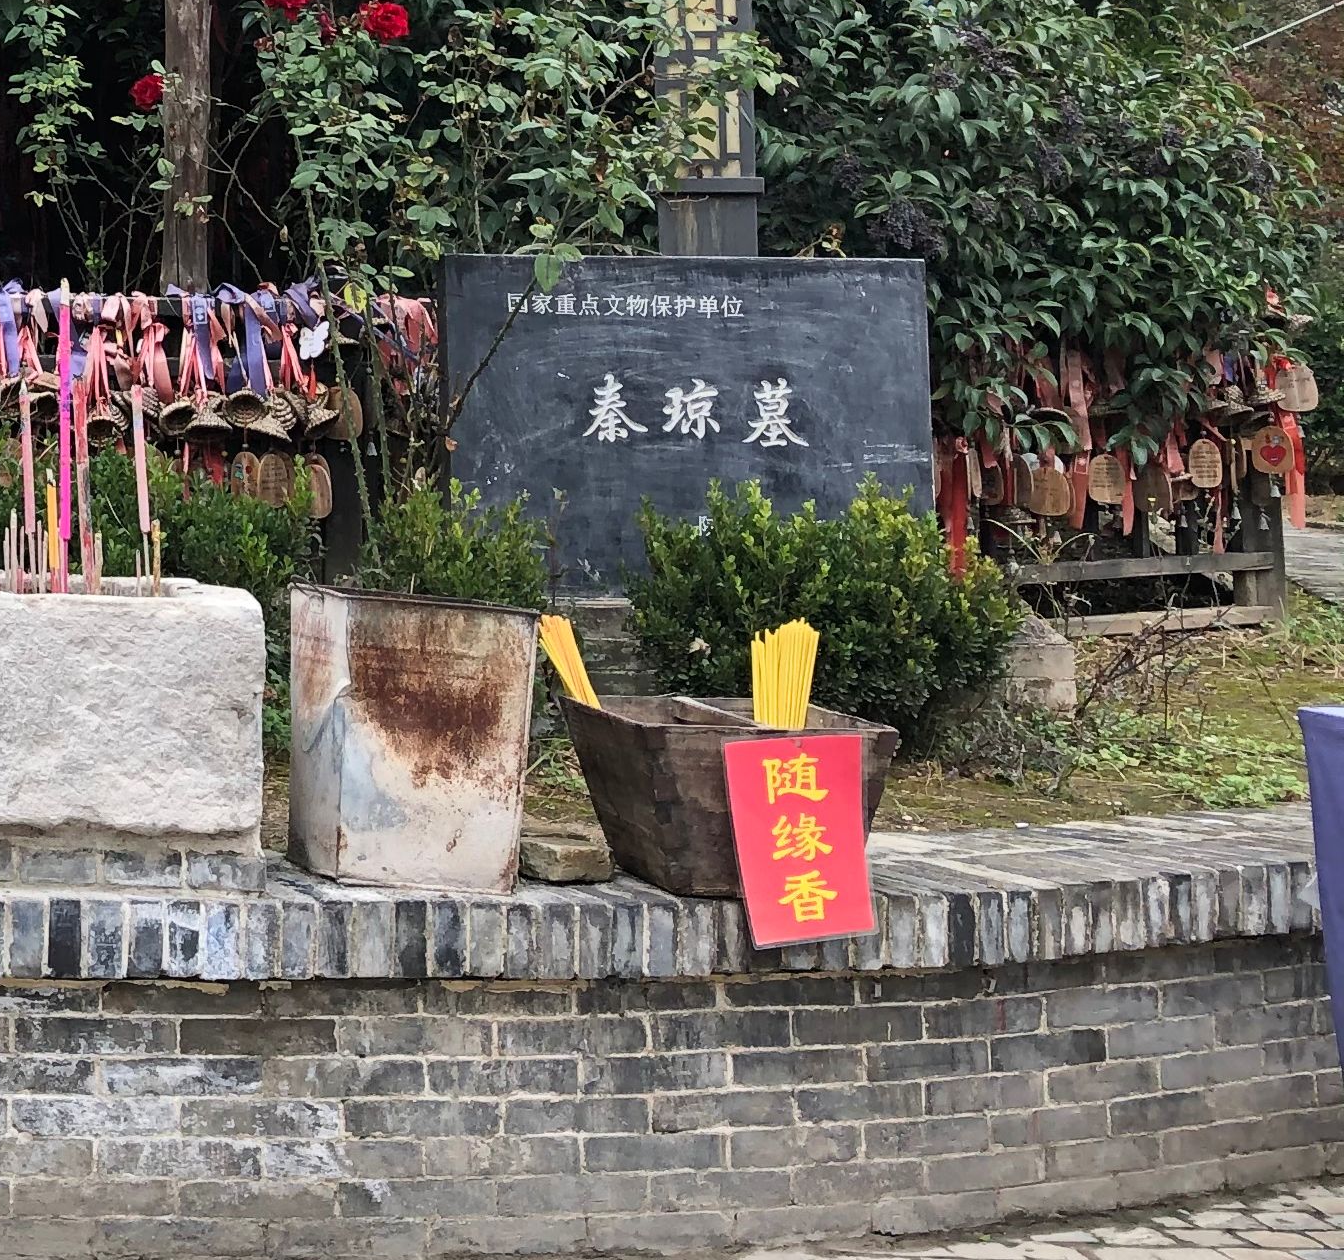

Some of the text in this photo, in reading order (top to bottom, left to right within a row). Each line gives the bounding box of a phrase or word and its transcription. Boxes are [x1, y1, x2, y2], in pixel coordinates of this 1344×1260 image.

[507, 292, 745, 318] 国家重点文物保护单位
[583, 374, 809, 447] 秦琼墓
[763, 753, 837, 922] 随缘香
